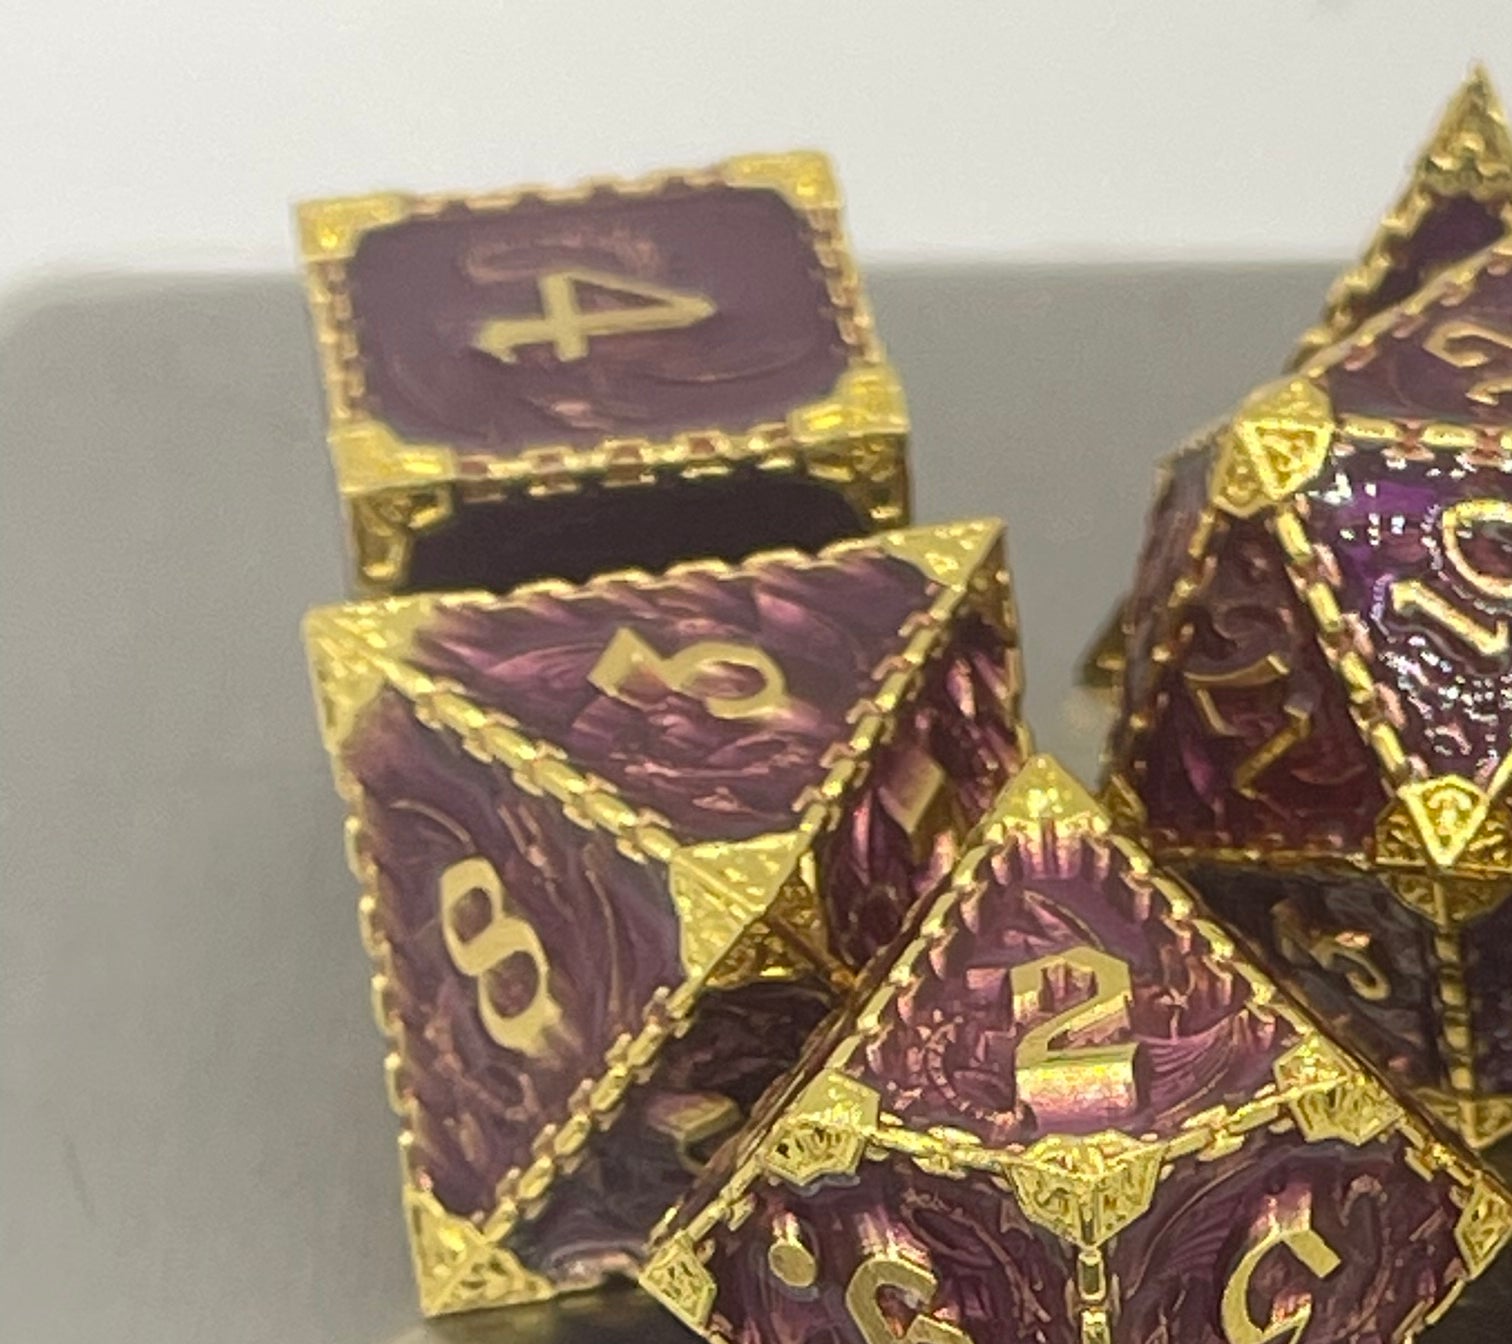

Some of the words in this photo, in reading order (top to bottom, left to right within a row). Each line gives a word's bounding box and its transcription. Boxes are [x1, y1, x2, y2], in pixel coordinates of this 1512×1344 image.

[471, 267, 716, 364] 4
[438, 856, 558, 1058] 8
[1009, 946, 1140, 1105] 2
